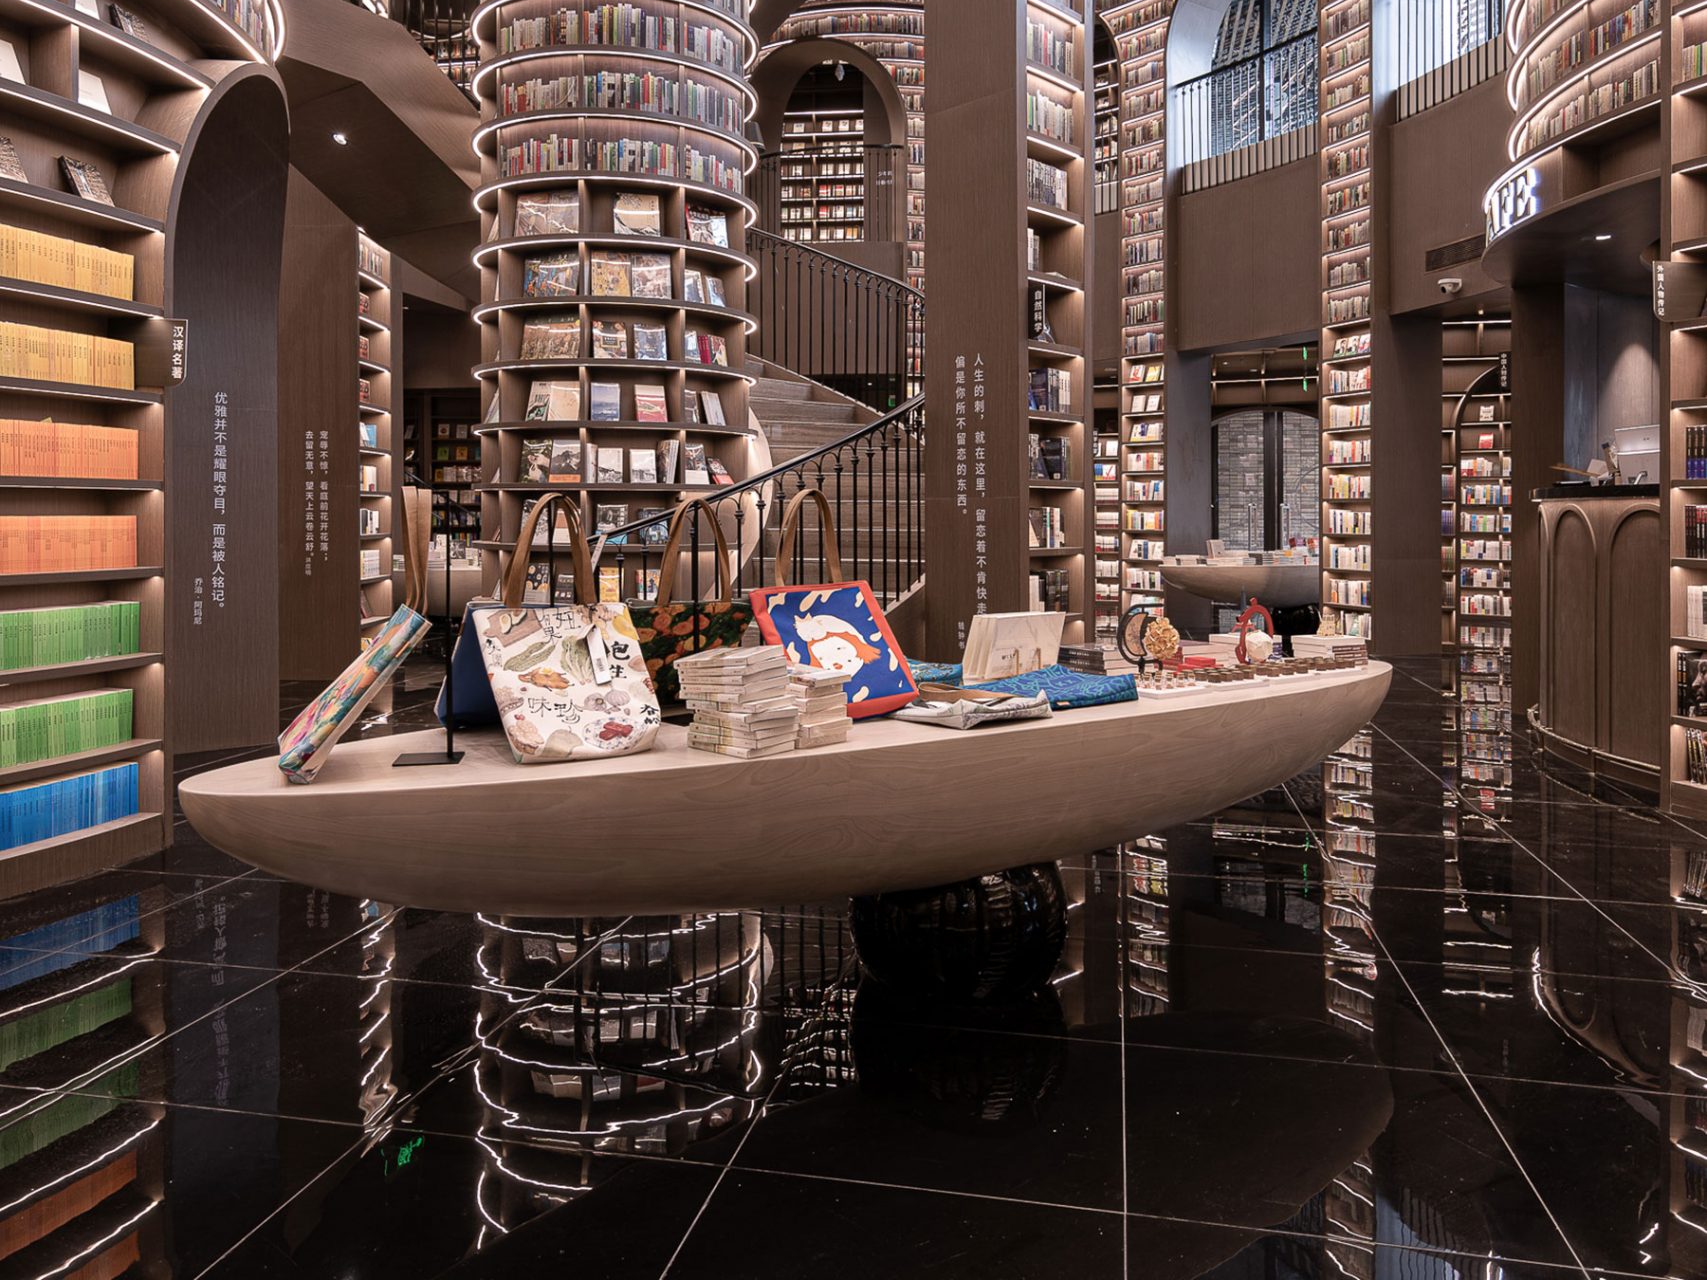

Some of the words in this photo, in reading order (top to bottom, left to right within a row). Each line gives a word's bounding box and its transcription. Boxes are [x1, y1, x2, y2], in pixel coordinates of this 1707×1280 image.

[171, 325, 185, 379] 汉译名著
[1033, 290, 1043, 333] 自然科学
[955, 355, 968, 515] 偏是你所不留恋的东西。
[211, 391, 229, 609] 优雅并不是耀眼夺目，而是被人铭记。
